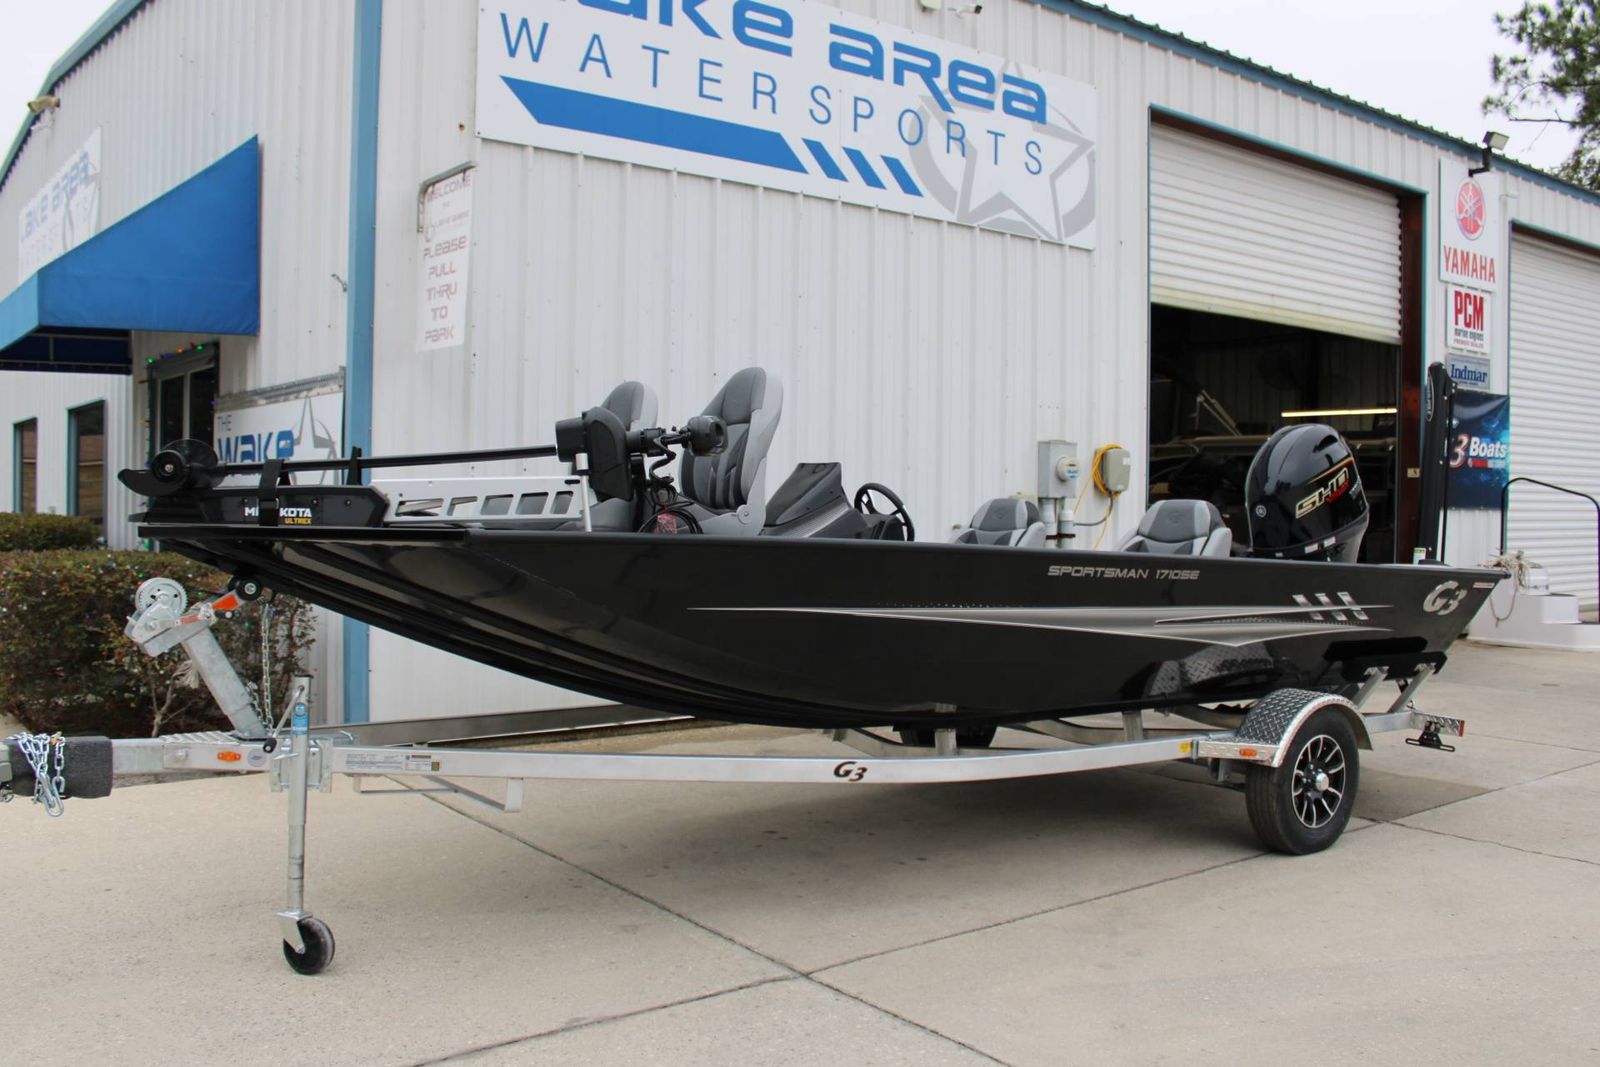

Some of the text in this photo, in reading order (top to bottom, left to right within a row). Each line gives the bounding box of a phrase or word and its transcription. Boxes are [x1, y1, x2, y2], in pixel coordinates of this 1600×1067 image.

[500, 13, 1043, 175] WATERSPORTS
[428, 262, 457, 280] PULL
[1443, 246, 1496, 283] YAMAHA
[425, 282, 458, 301] THRU
[431, 305, 449, 320] TO
[1454, 290, 1484, 331] PCM
[1451, 363, 1488, 383] Indmar
[1469, 436, 1508, 458] Boats
[1295, 467, 1349, 519] SHO
[279, 507, 312, 518] KOTA
[1048, 565, 1150, 579] SPORTSMAN
[1423, 580, 1468, 615] G3
[834, 760, 868, 782] G3
